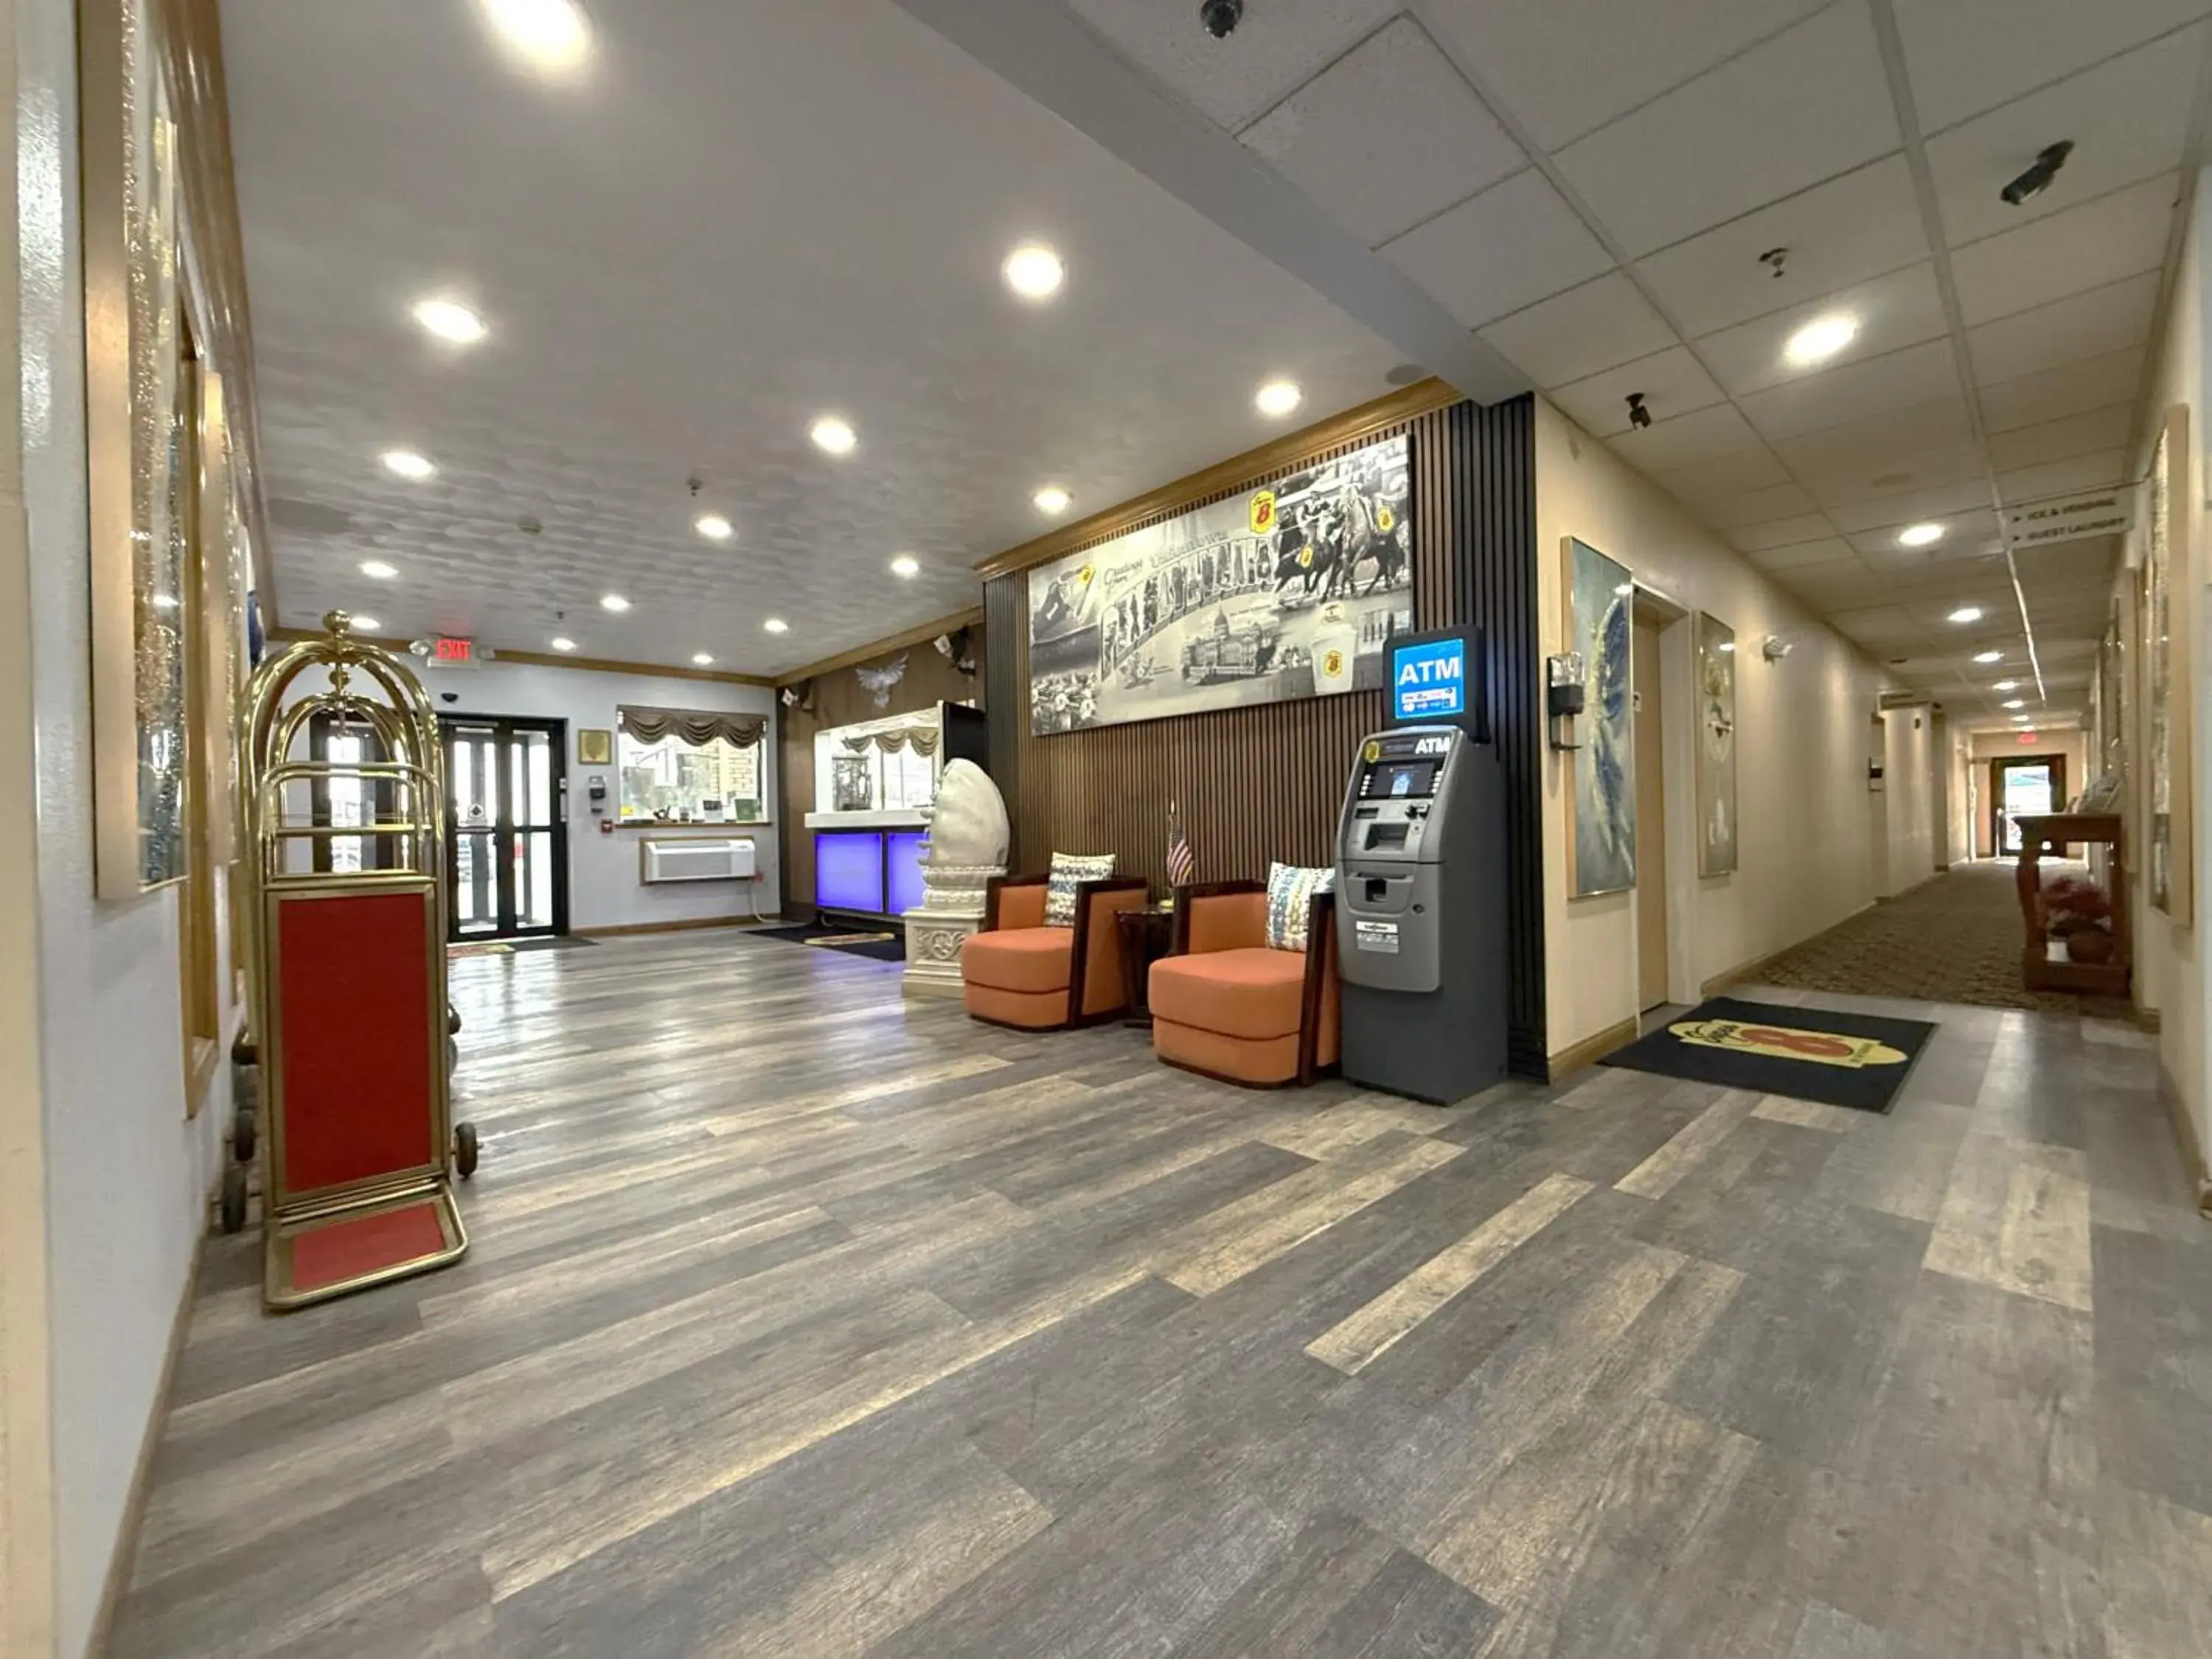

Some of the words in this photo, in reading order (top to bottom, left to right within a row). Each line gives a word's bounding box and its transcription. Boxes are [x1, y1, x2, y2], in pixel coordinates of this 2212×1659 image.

[437, 639, 471, 660] EXIT
[1399, 656, 1460, 686] ATM
[1415, 737, 1450, 754] ATM
